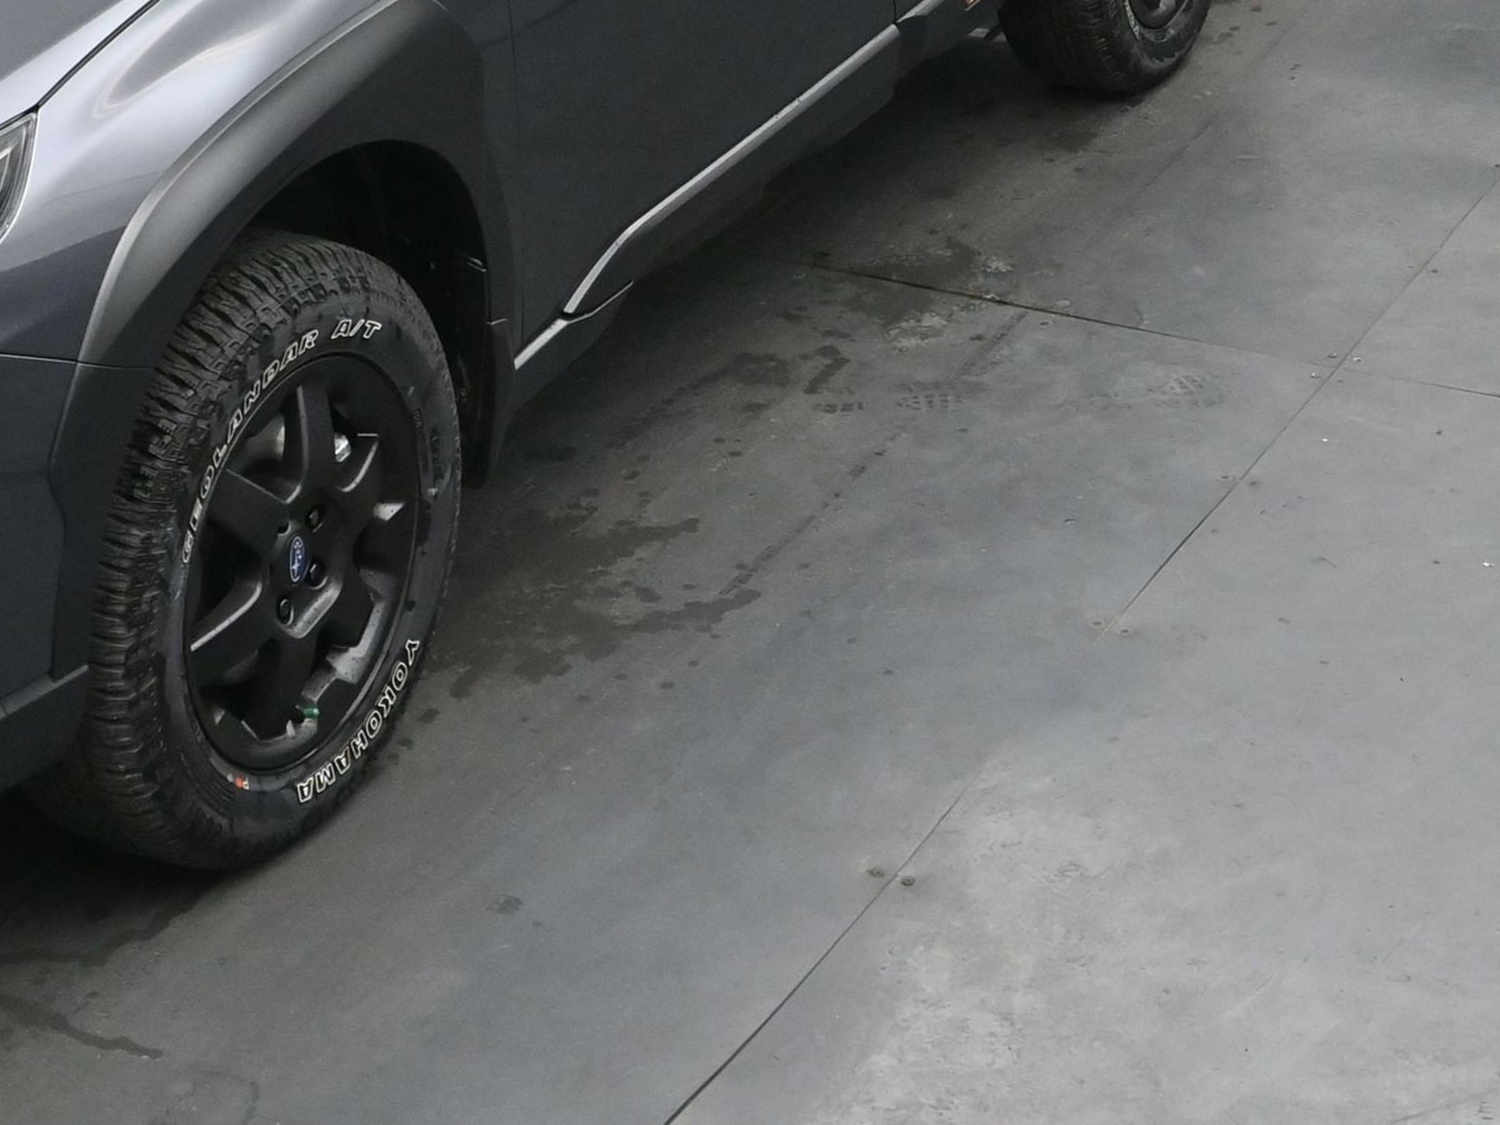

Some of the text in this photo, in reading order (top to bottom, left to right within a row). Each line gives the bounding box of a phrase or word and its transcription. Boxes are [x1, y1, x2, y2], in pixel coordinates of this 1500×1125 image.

[181, 318, 383, 563] GEOLANDAR A/T
[296, 639, 421, 804] YOKOHAMA
